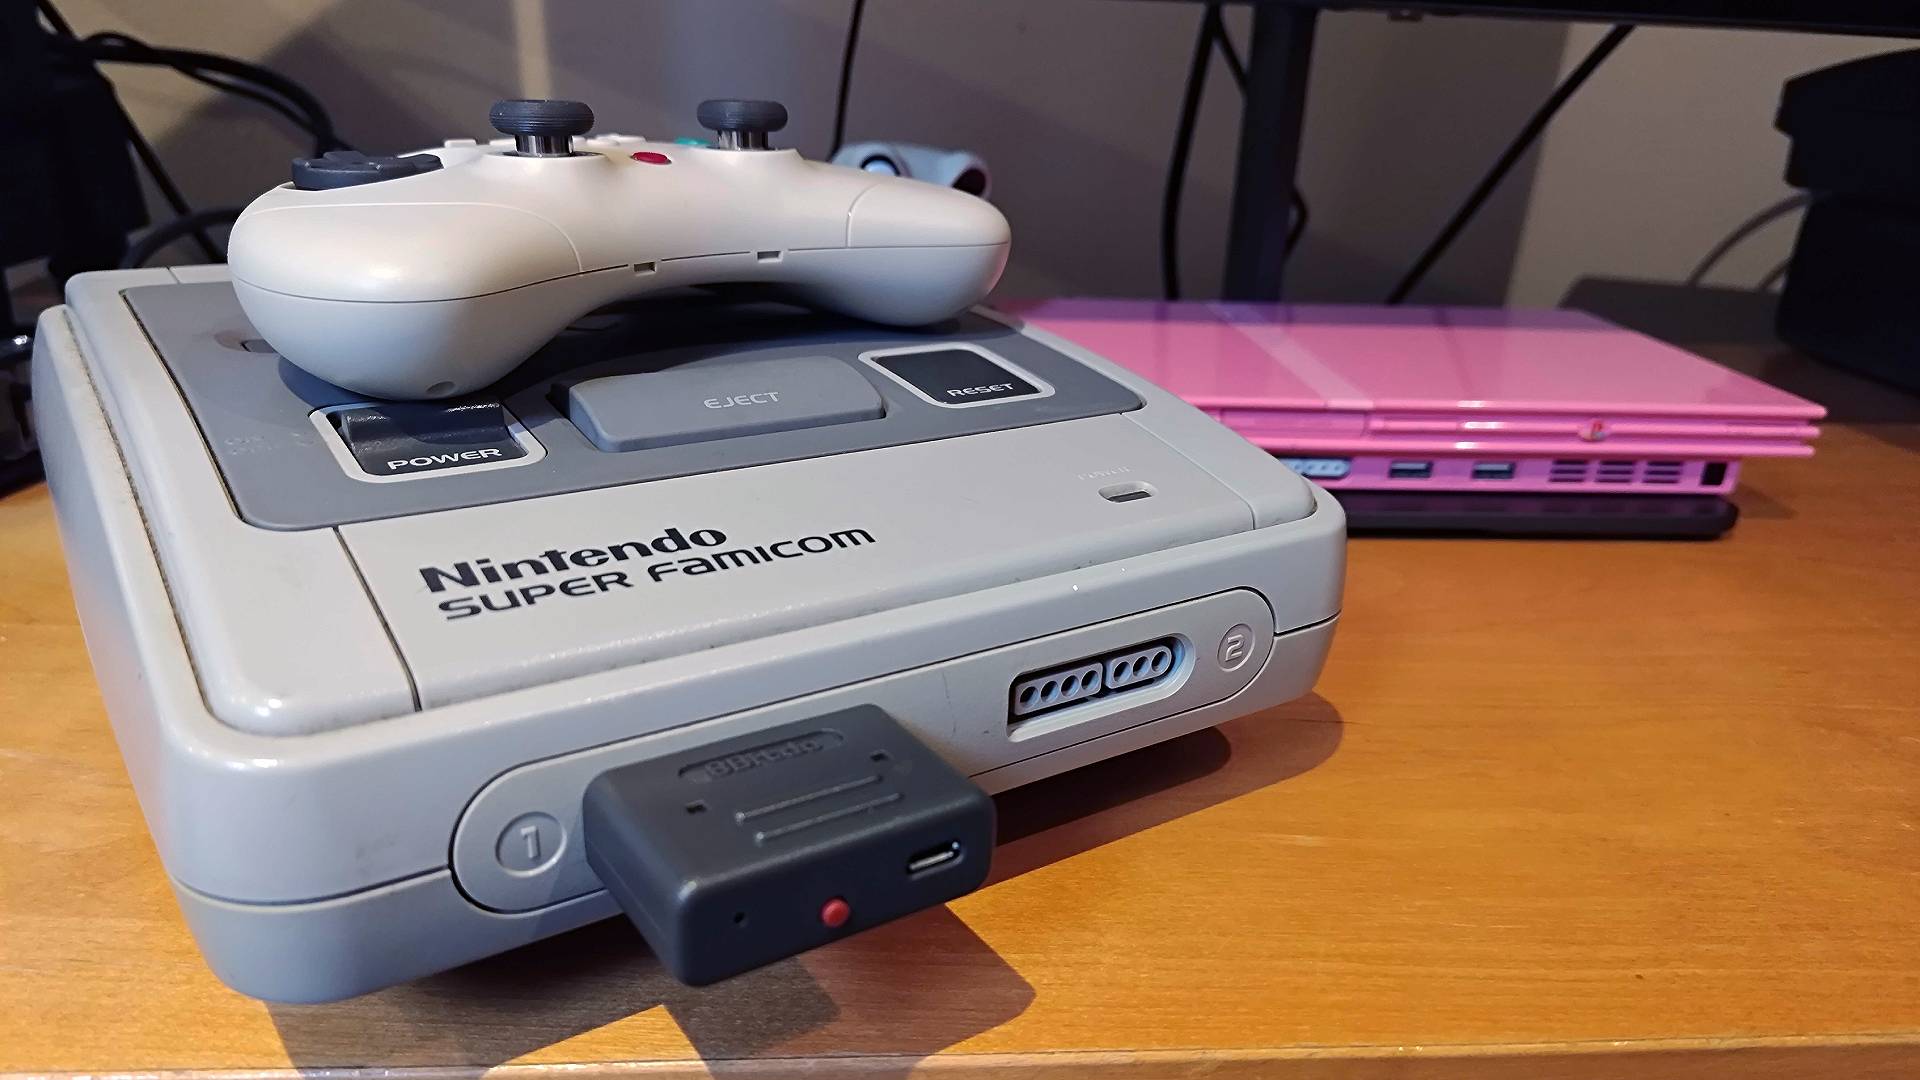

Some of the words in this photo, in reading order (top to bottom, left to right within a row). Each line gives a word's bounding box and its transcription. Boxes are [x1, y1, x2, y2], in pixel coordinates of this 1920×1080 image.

[703, 391, 779, 409] EJECT
[946, 383, 1014, 397] RESET
[387, 448, 502, 470] POWER
[419, 527, 727, 592] Nintendo
[438, 571, 635, 620] SUPER
[1225, 634, 1244, 662] 2
[520, 826, 542, 860] 1
